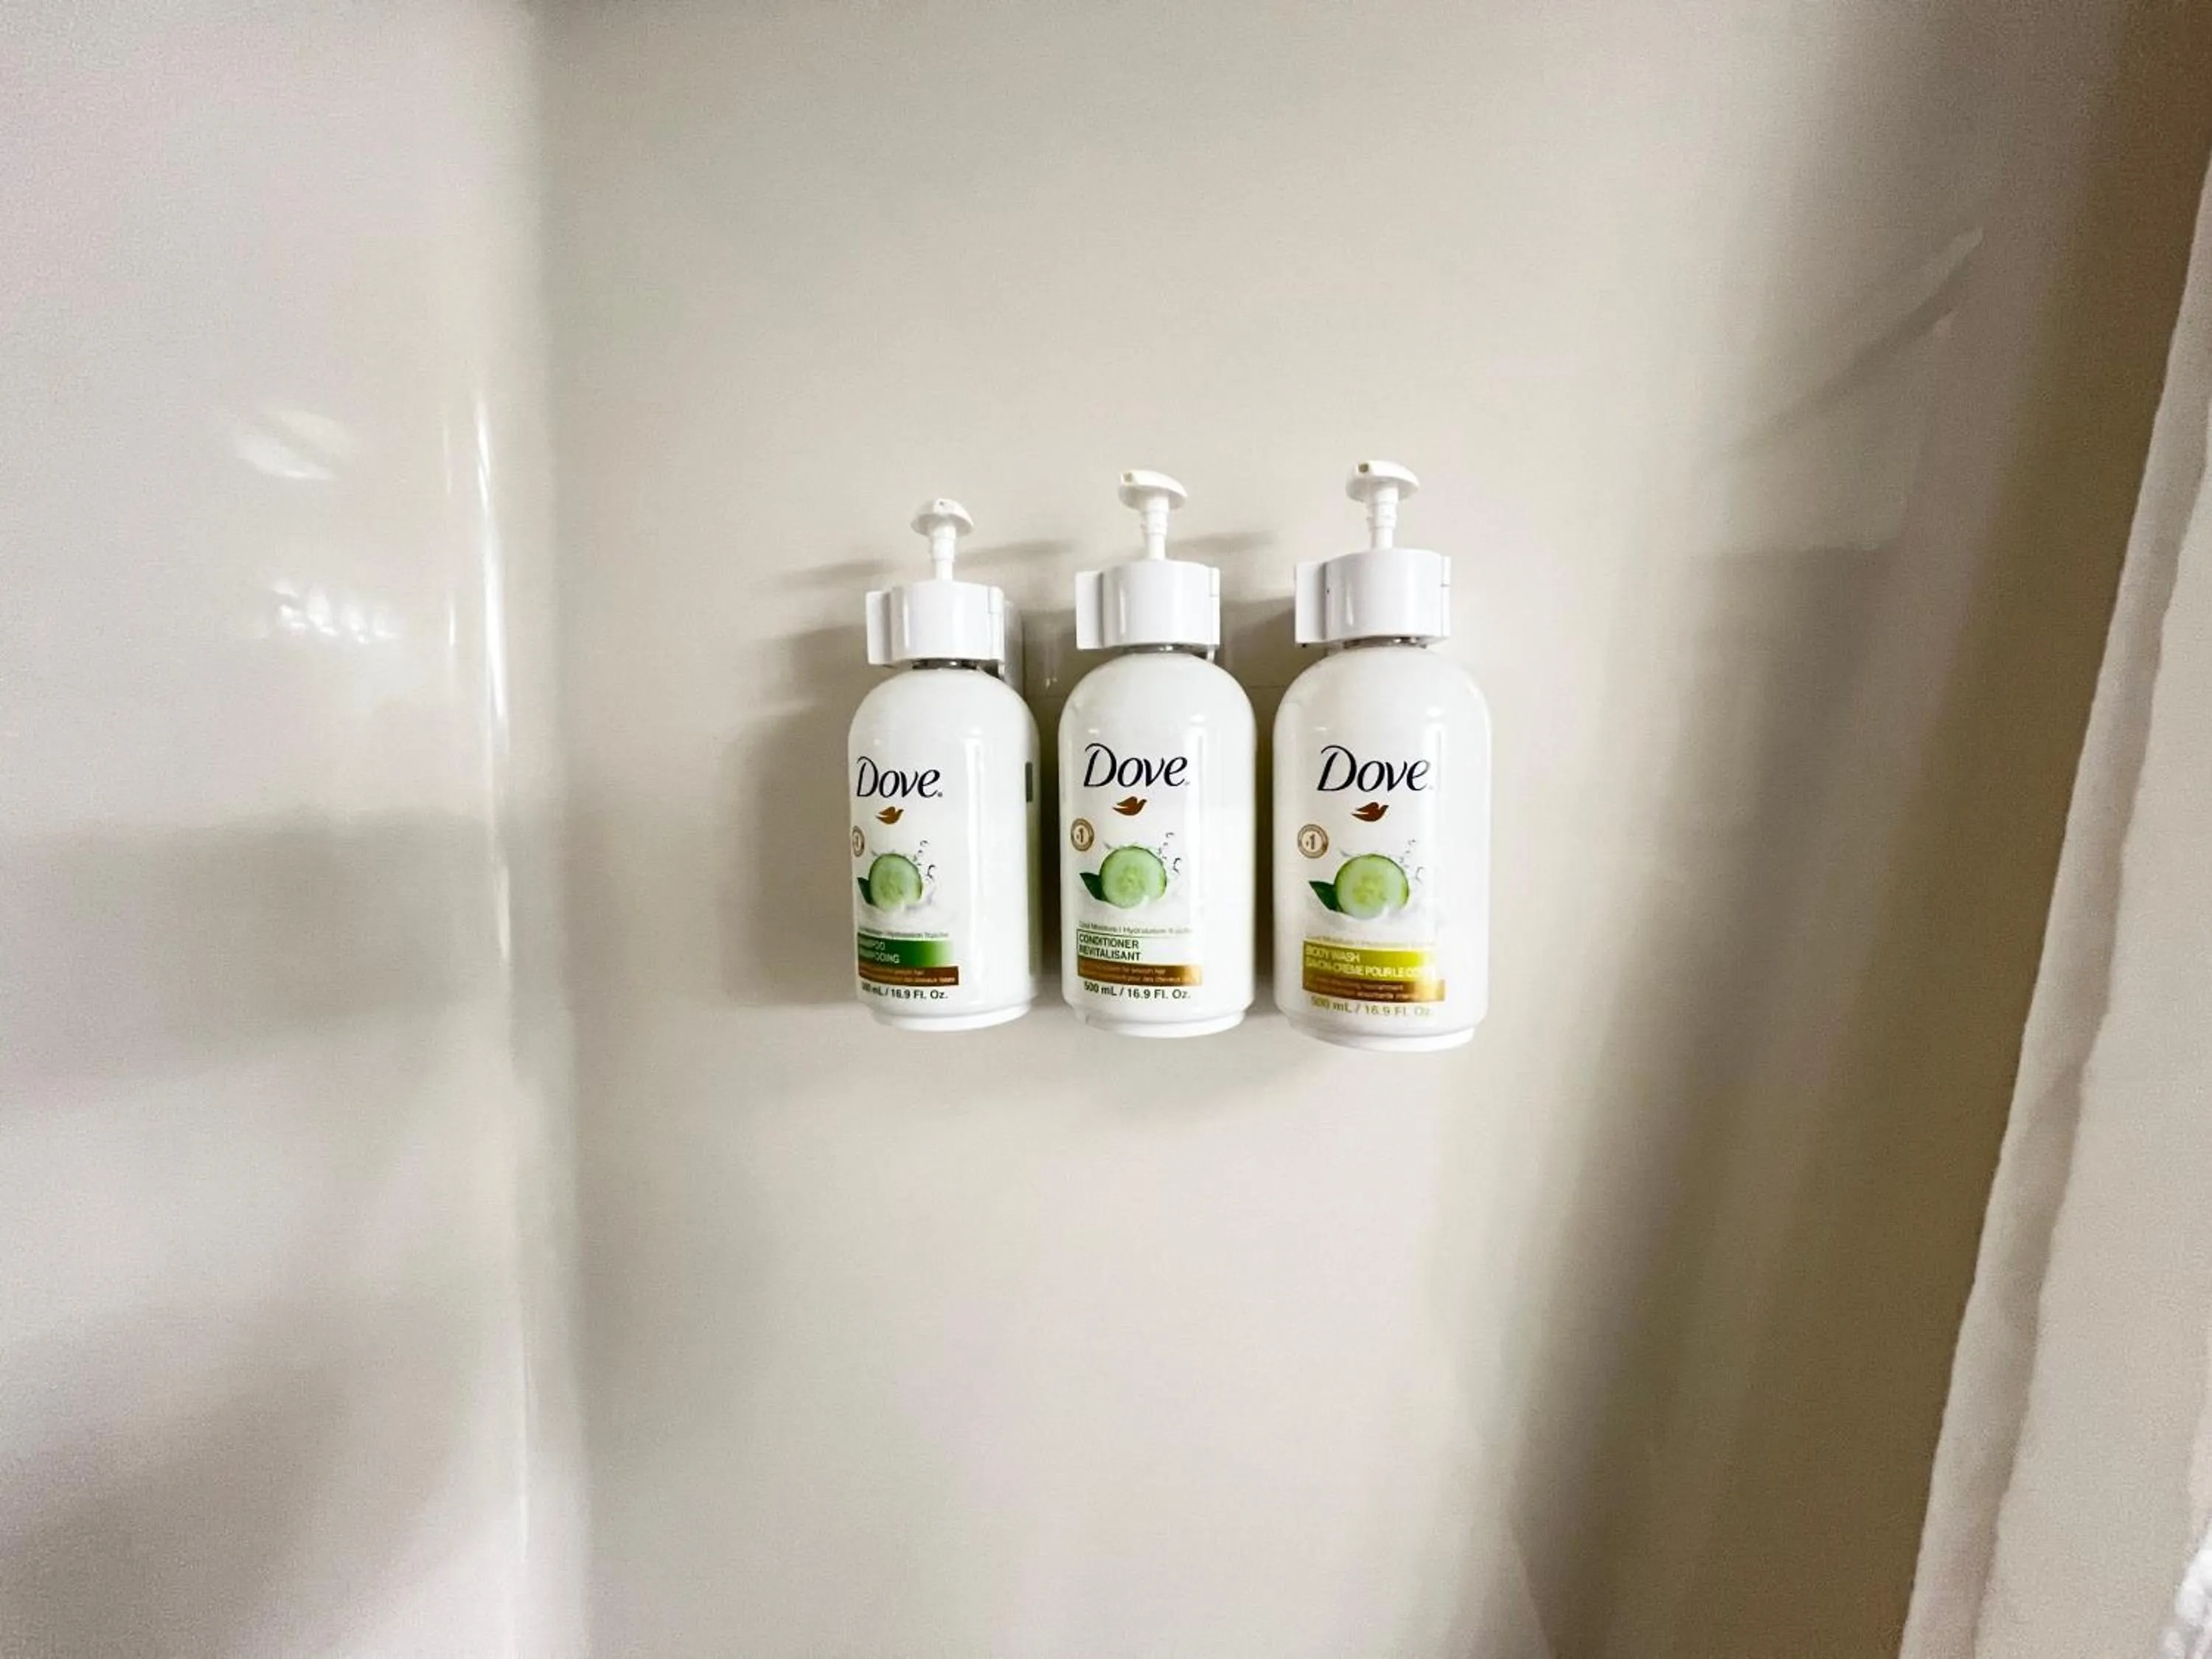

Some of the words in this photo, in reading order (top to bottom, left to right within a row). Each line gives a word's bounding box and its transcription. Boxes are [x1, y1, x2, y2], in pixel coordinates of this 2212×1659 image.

[1083, 742, 1189, 787] Dove
[1316, 744, 1431, 792] Dove
[1079, 933, 1139, 949] CONDITIONER
[1079, 945, 1142, 961] REVITALISANT
[1305, 945, 1329, 959] BODY
[1330, 947, 1360, 963] WASH
[1366, 966, 1392, 977] POUR
[891, 989, 911, 999] 16.9
[930, 989, 948, 999] Oz.
[1084, 981, 1099, 993] 500
[1101, 984, 1117, 996] mL
[1127, 988, 1151, 999] 16.9
[1172, 989, 1191, 999] Oz.
[1332, 1000, 1353, 1012] mL
